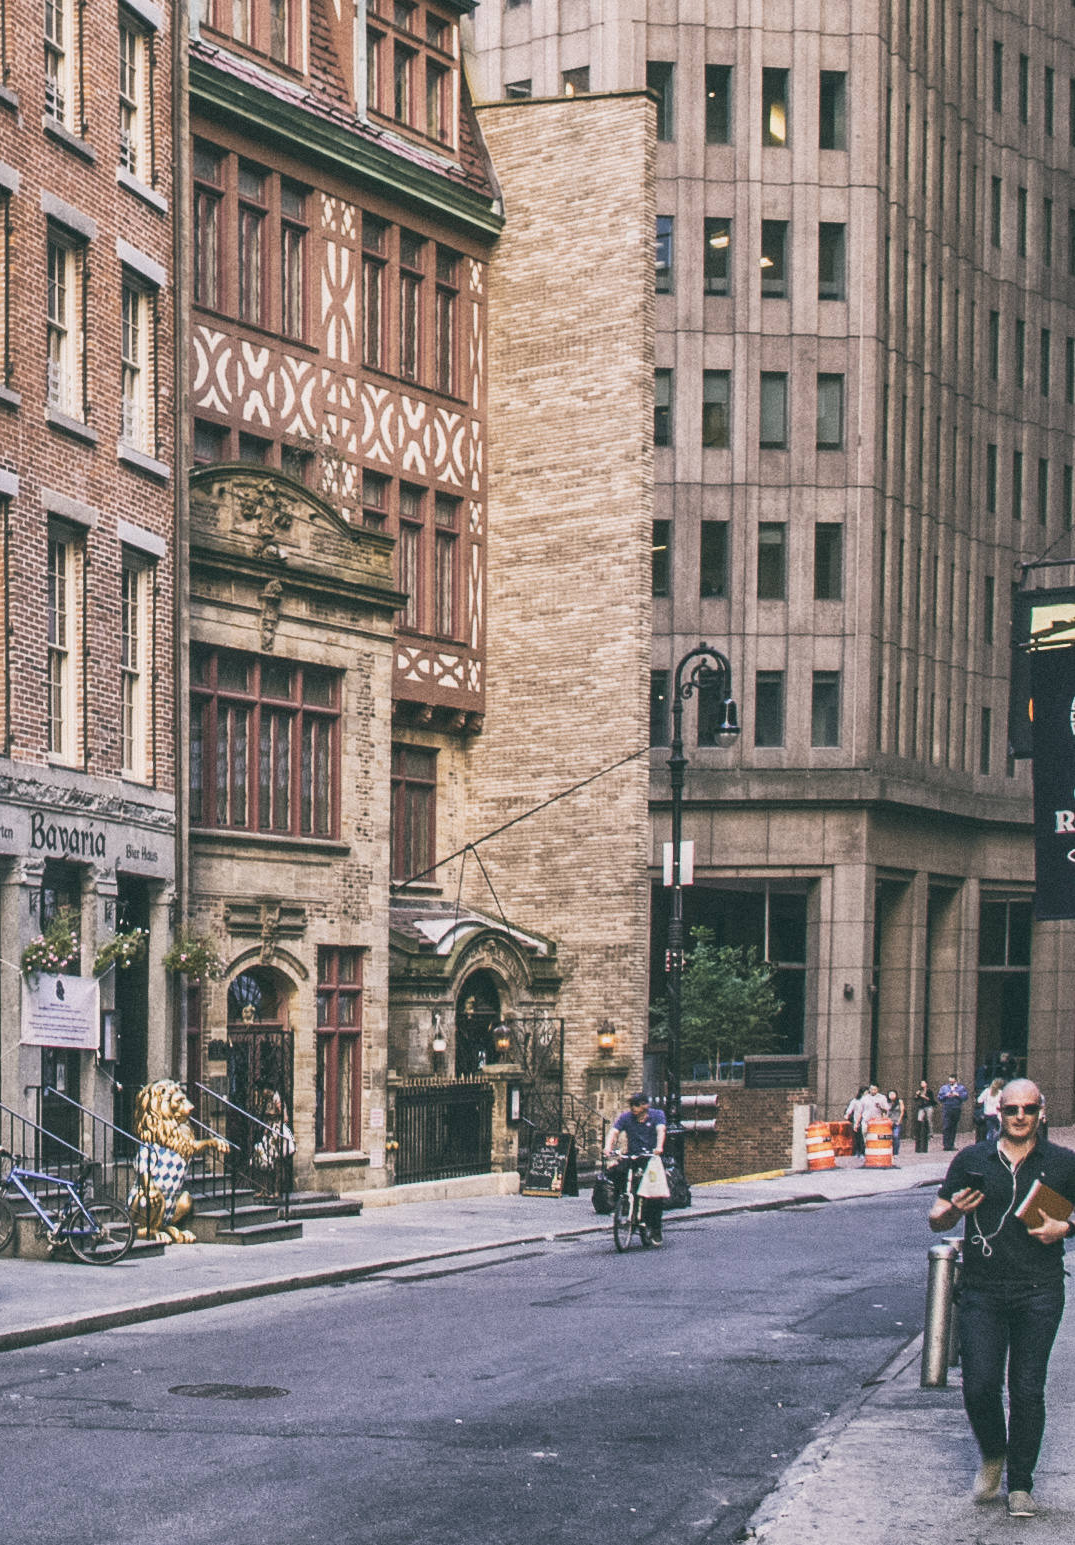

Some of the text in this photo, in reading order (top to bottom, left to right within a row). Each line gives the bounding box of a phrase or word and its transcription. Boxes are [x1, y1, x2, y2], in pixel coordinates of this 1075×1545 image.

[1055, 809, 1075, 834] R
[30, 812, 106, 858] Bavaria
[126, 844, 159, 863] Bier Haus
